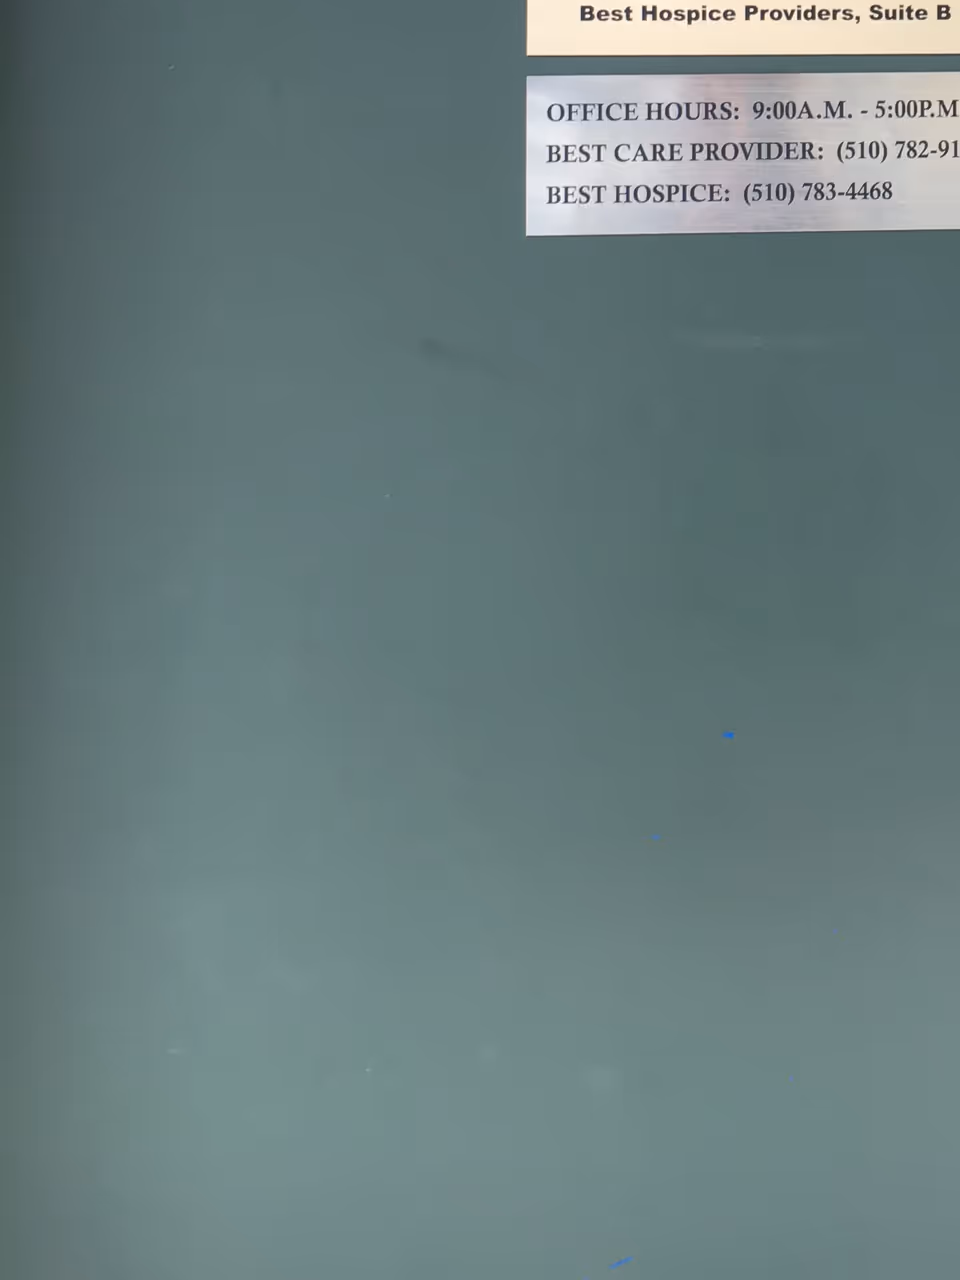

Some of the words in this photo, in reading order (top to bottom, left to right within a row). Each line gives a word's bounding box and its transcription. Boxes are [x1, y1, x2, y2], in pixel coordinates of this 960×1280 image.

[580, 5, 633, 21] Best
[641, 5, 736, 25] Hospice
[744, 5, 861, 24] Providers,
[869, 4, 928, 21] Suite
[936, 5, 952, 21] B
[546, 102, 639, 122] OFFICE
[645, 101, 740, 121] HOURS:
[752, 100, 853, 120] 9:00A.M.
[546, 144, 607, 163] BEST
[614, 143, 683, 162] CARE
[689, 141, 824, 161] PROVIDER:
[836, 140, 888, 163] (510)
[546, 185, 607, 204] BEST
[613, 183, 730, 204] HOSPICE:
[743, 182, 796, 206] (510)
[802, 181, 893, 201] 783-4468
